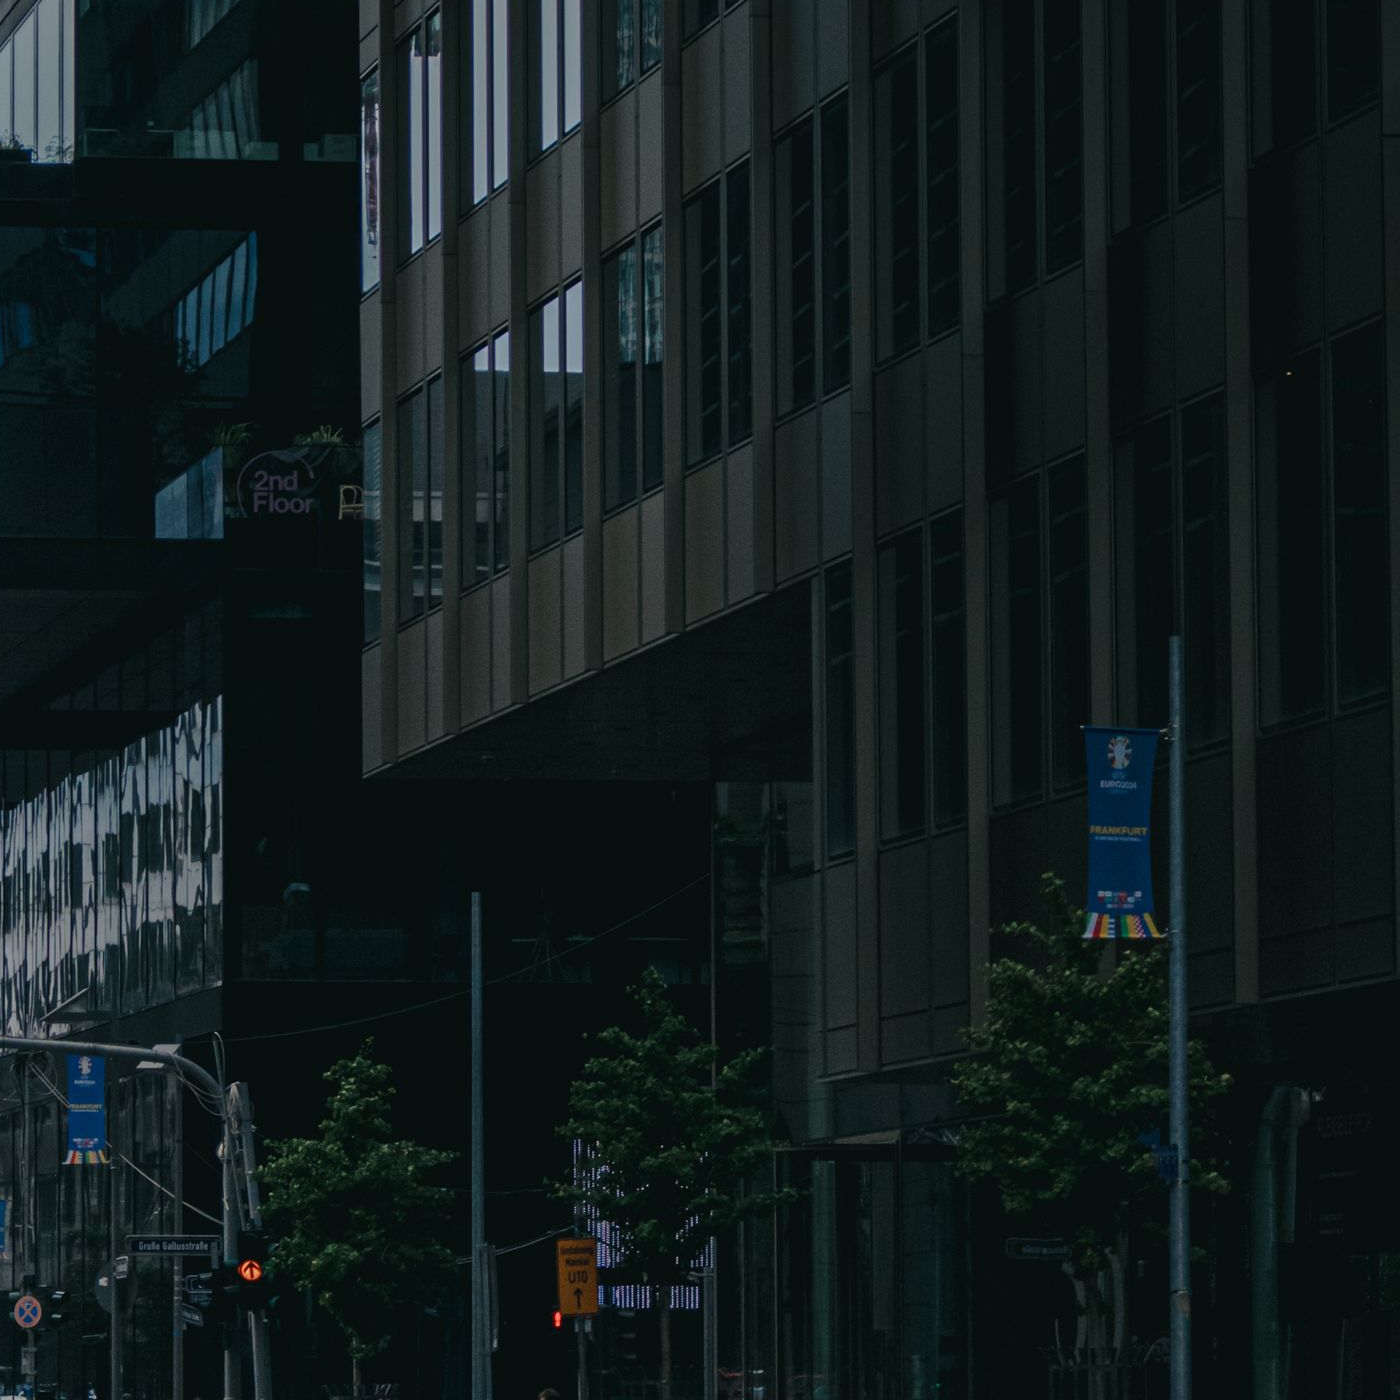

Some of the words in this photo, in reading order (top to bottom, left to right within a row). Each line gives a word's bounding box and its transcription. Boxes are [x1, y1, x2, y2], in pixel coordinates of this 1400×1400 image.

[253, 470, 298, 491] 2nd
[253, 491, 315, 514] Floor
[1089, 825, 1148, 836] FRANKFURT
[138, 1241, 160, 1251] Große
[162, 1240, 209, 1251] Gallusstraße
[568, 1270, 588, 1283] U10
